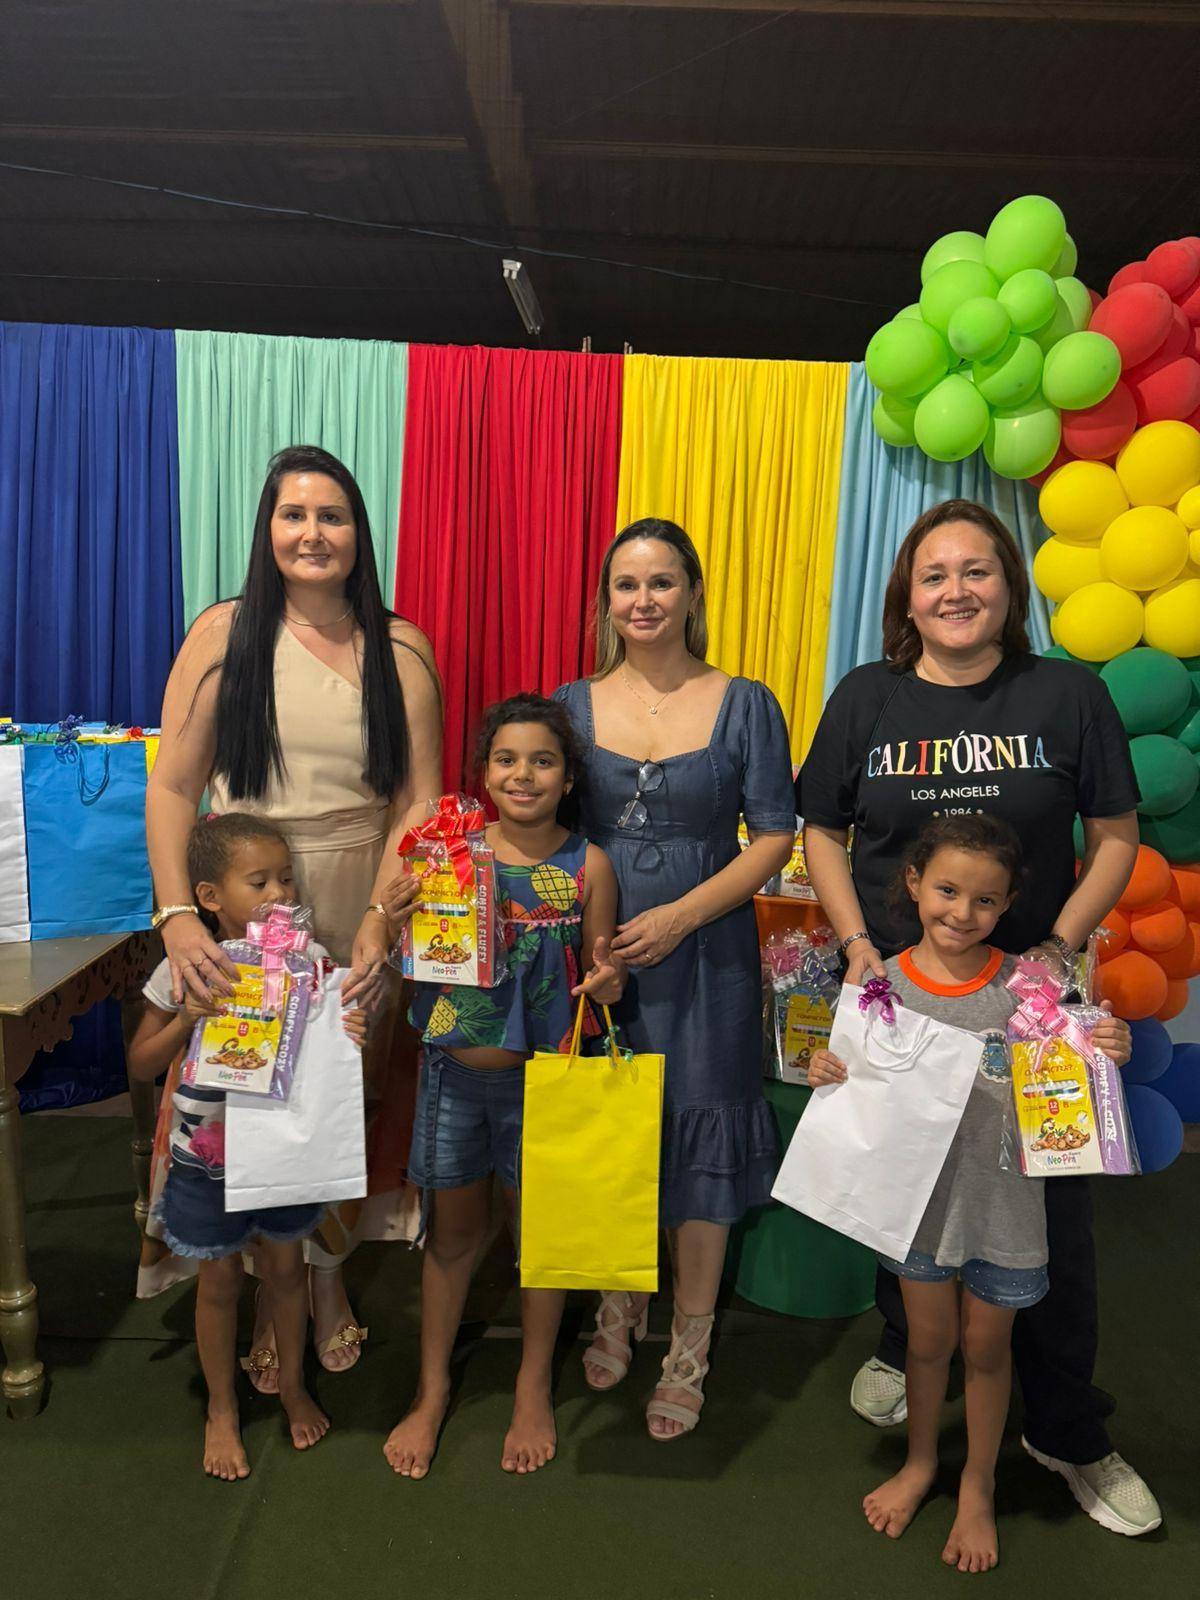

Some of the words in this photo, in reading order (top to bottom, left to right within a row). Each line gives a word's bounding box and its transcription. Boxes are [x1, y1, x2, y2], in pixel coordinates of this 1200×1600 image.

[867, 730, 1052, 778] CALIFÓRNIA
[911, 789, 936, 801] LOS
[940, 785, 1000, 799] ANGELES
[286, 995, 300, 1033] COMFY
[276, 1044, 290, 1072] COZY
